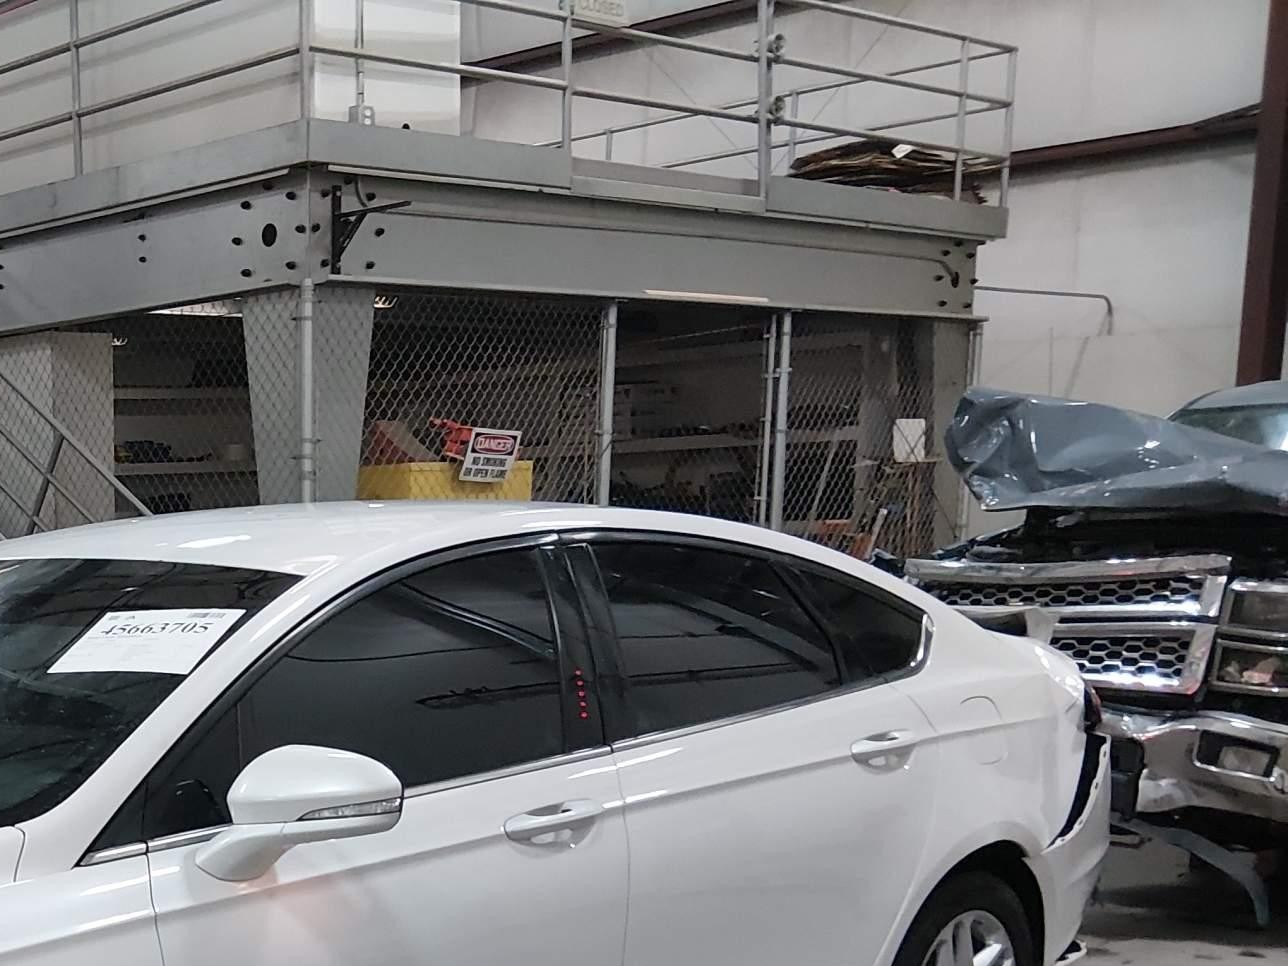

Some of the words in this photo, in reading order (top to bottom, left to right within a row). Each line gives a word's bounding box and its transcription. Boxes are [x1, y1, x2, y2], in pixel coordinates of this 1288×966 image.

[476, 437, 513, 451] DANGER
[472, 456, 481, 465] NO
[481, 457, 507, 467] SMOKING
[463, 467, 472, 476] OR
[473, 468, 489, 477] OPEN
[100, 622, 214, 636] 45663705
